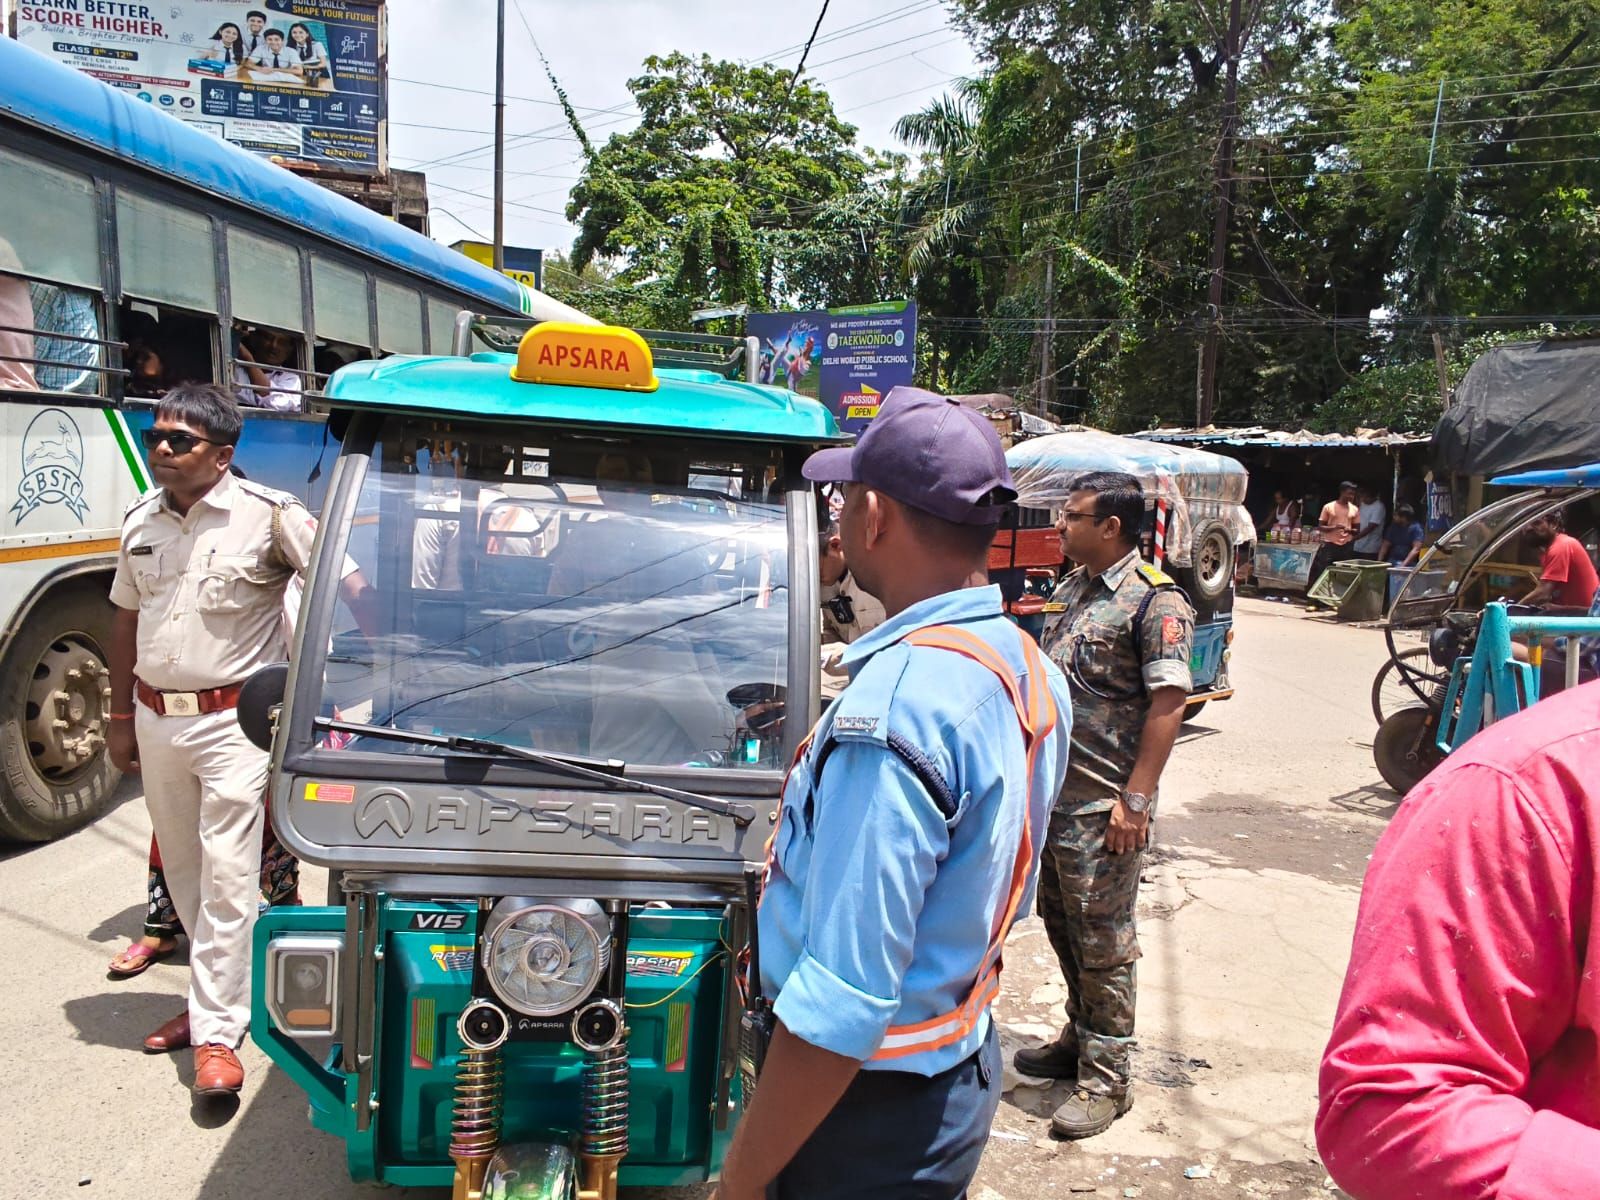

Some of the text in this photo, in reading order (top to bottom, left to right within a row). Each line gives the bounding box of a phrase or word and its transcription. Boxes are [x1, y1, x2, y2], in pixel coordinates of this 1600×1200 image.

[85, 0, 154, 21] BETTER,
[292, 6, 320, 16] SHAPE
[322, 9, 343, 19] YOUR
[22, 6, 169, 39] SCORE HIGHER,
[77, 28, 116, 39] Brighter
[57, 44, 90, 54] CLASS
[838, 333, 894, 346] TAEKWONDO
[538, 343, 630, 373] APSARA
[822, 354, 909, 365] DELHI WORLD PUBLIC SCHOOL
[842, 395, 877, 405] ADMISSION
[854, 407, 872, 416] OPEN
[23, 468, 81, 499] SBSTC
[425, 794, 720, 842] APSARA
